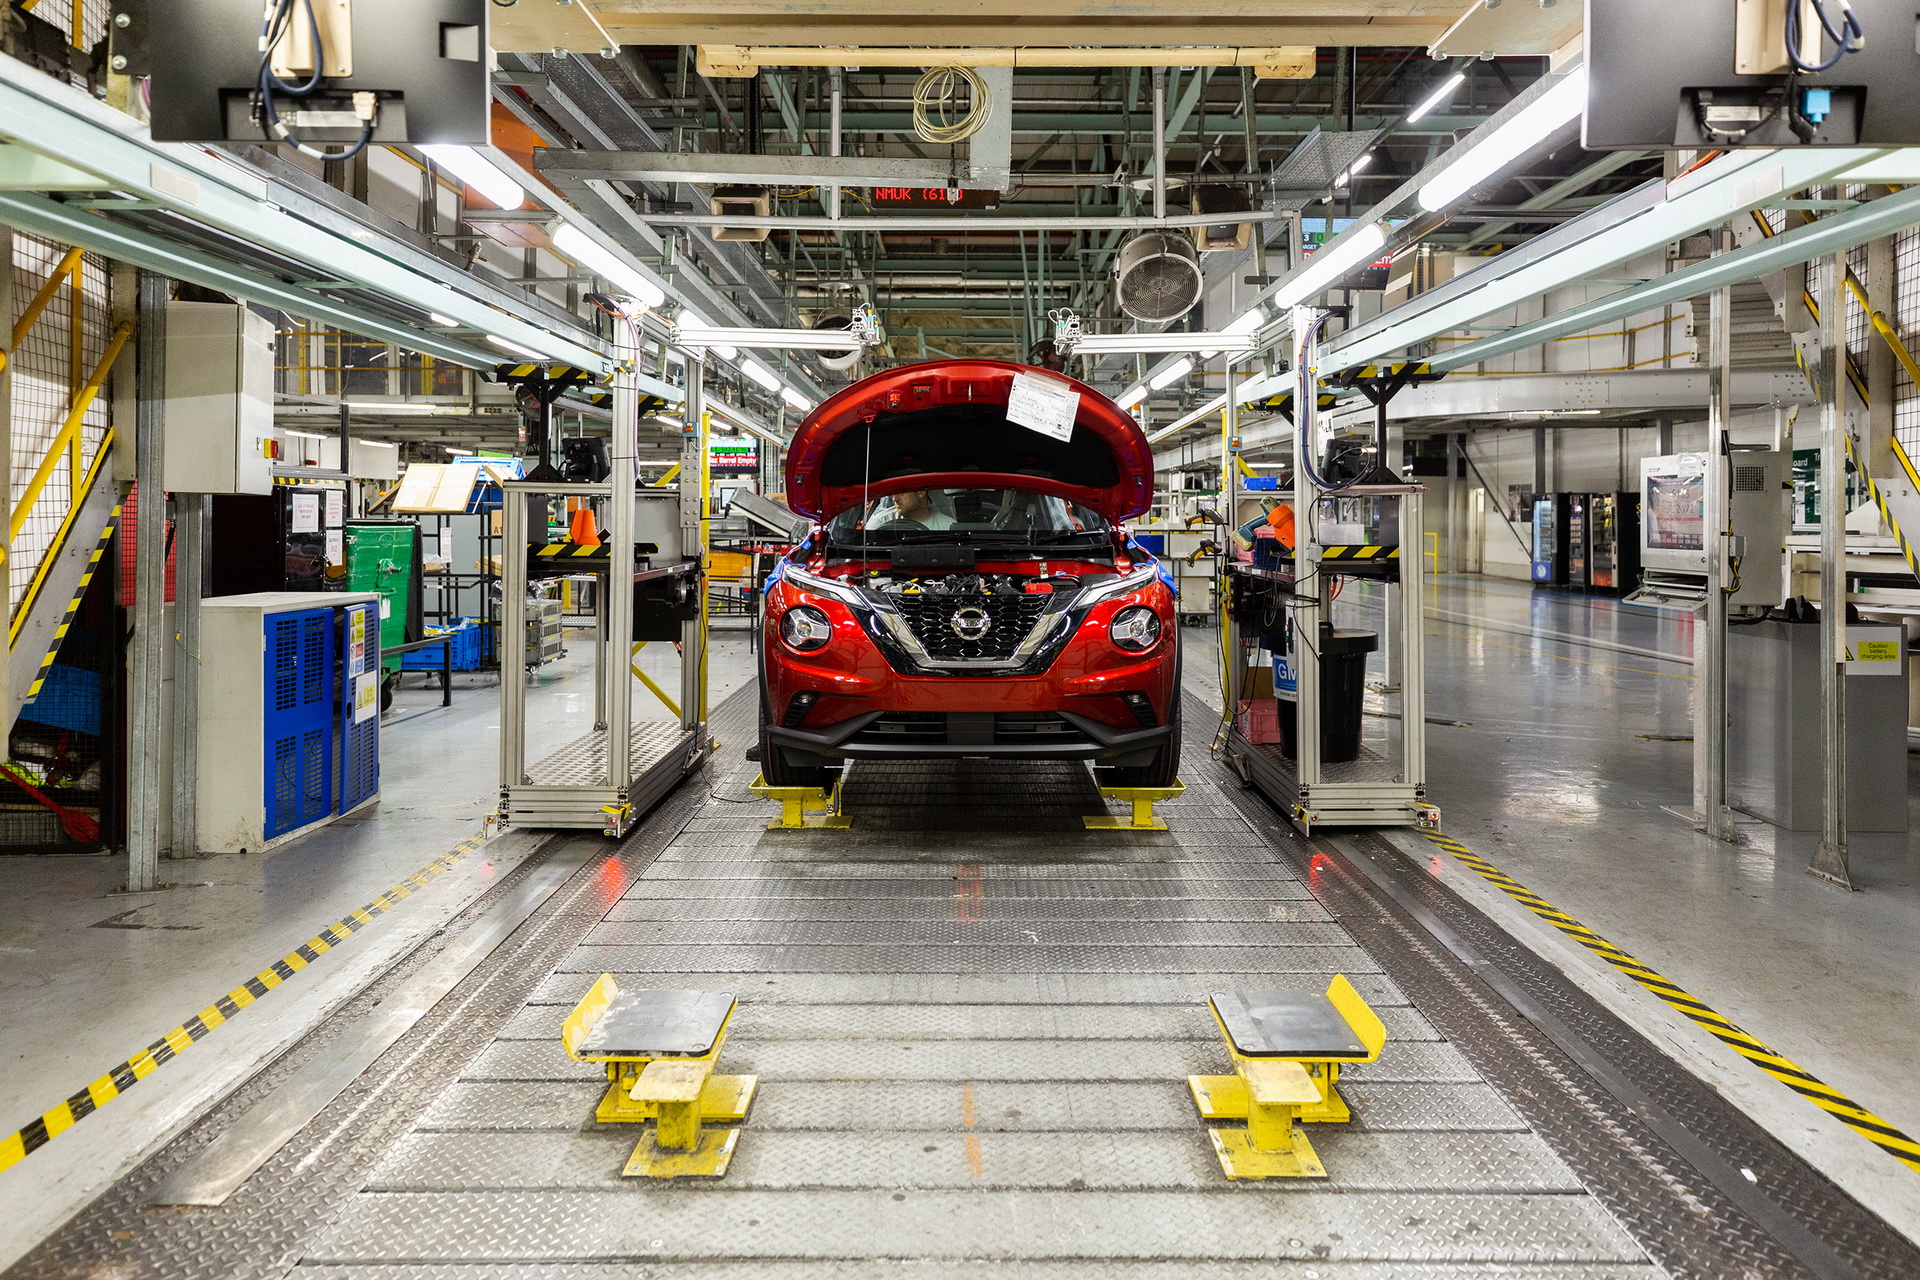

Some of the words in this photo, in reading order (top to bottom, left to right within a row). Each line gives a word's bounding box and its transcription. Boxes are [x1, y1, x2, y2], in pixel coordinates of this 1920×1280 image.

[875, 187, 911, 200] NMUK
[922, 187, 963, 200] (61)
[738, 456, 757, 466] Empty
